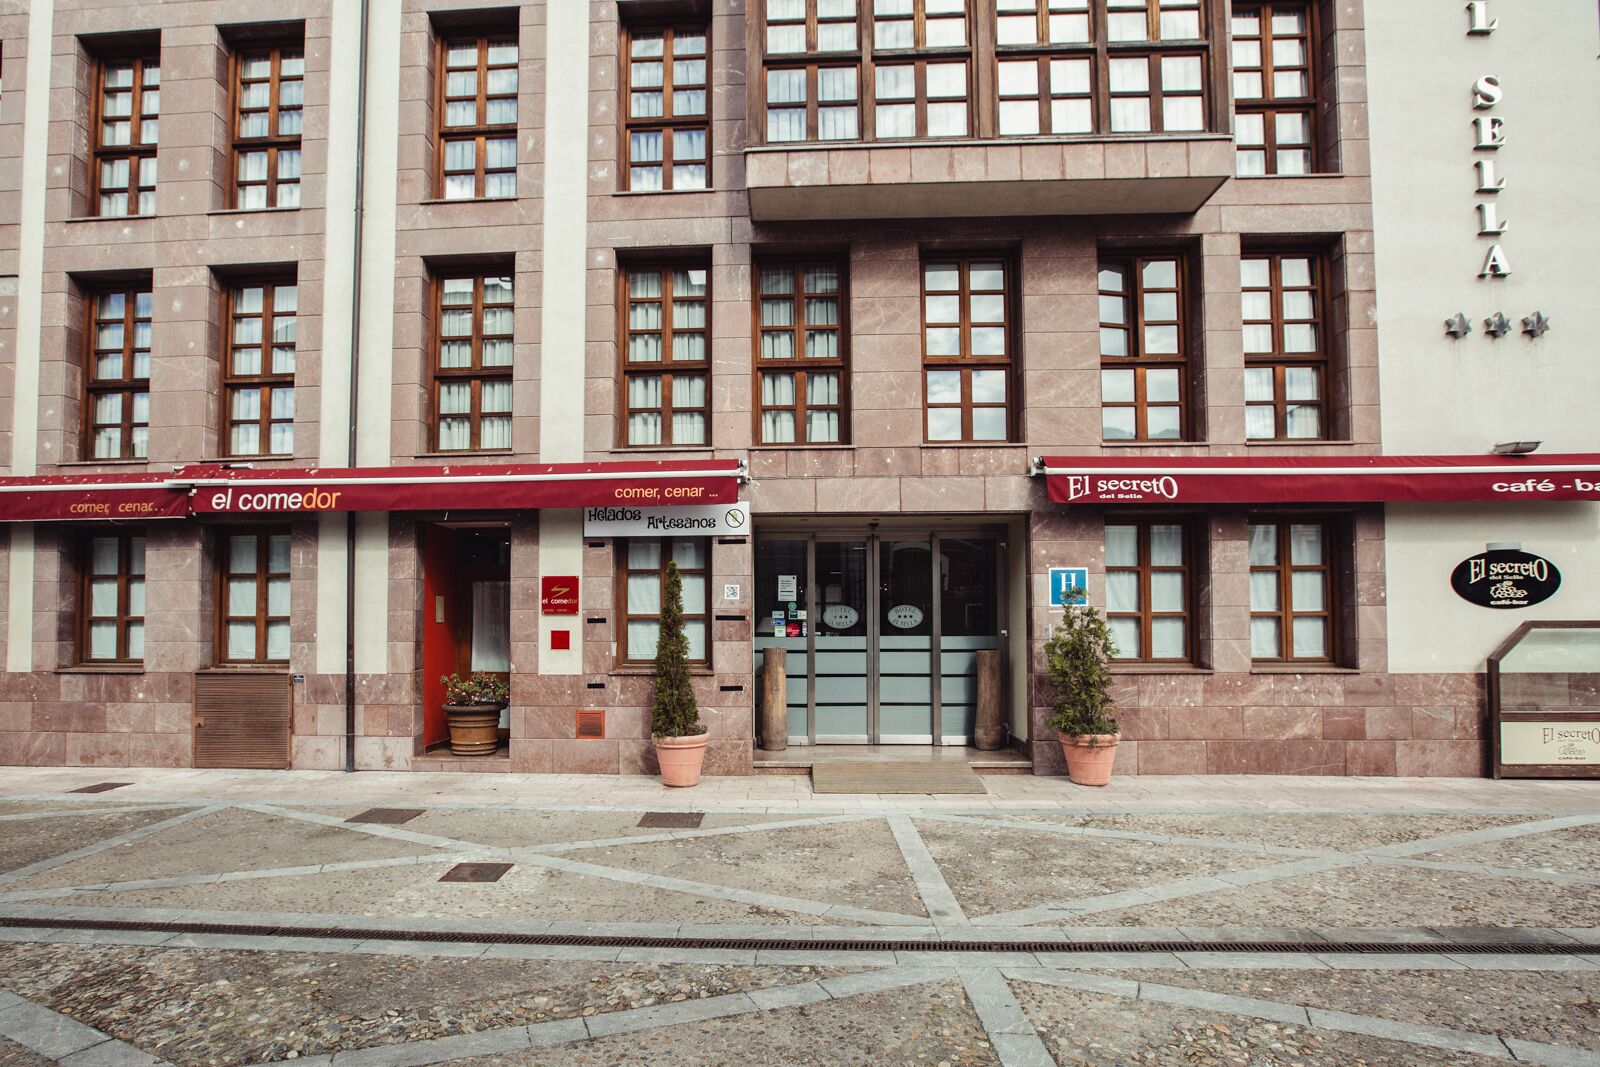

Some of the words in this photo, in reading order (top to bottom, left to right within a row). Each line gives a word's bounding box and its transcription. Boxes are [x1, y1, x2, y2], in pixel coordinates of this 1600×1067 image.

[1472, 75, 1512, 278] SELLA
[614, 487, 661, 500] comer,
[1067, 475, 1091, 501] El
[1097, 475, 1179, 499] secretO
[1492, 479, 1556, 492] café
[211, 488, 233, 510] el
[238, 487, 342, 510] comedor
[70, 503, 110, 515] comer,
[588, 507, 642, 522] Helados
[647, 516, 717, 530] Artesanos
[1469, 559, 1486, 584] El
[1489, 559, 1548, 582] secretO
[1060, 572, 1077, 592] H
[894, 606, 916, 614] HOTEL
[1543, 727, 1554, 744] El
